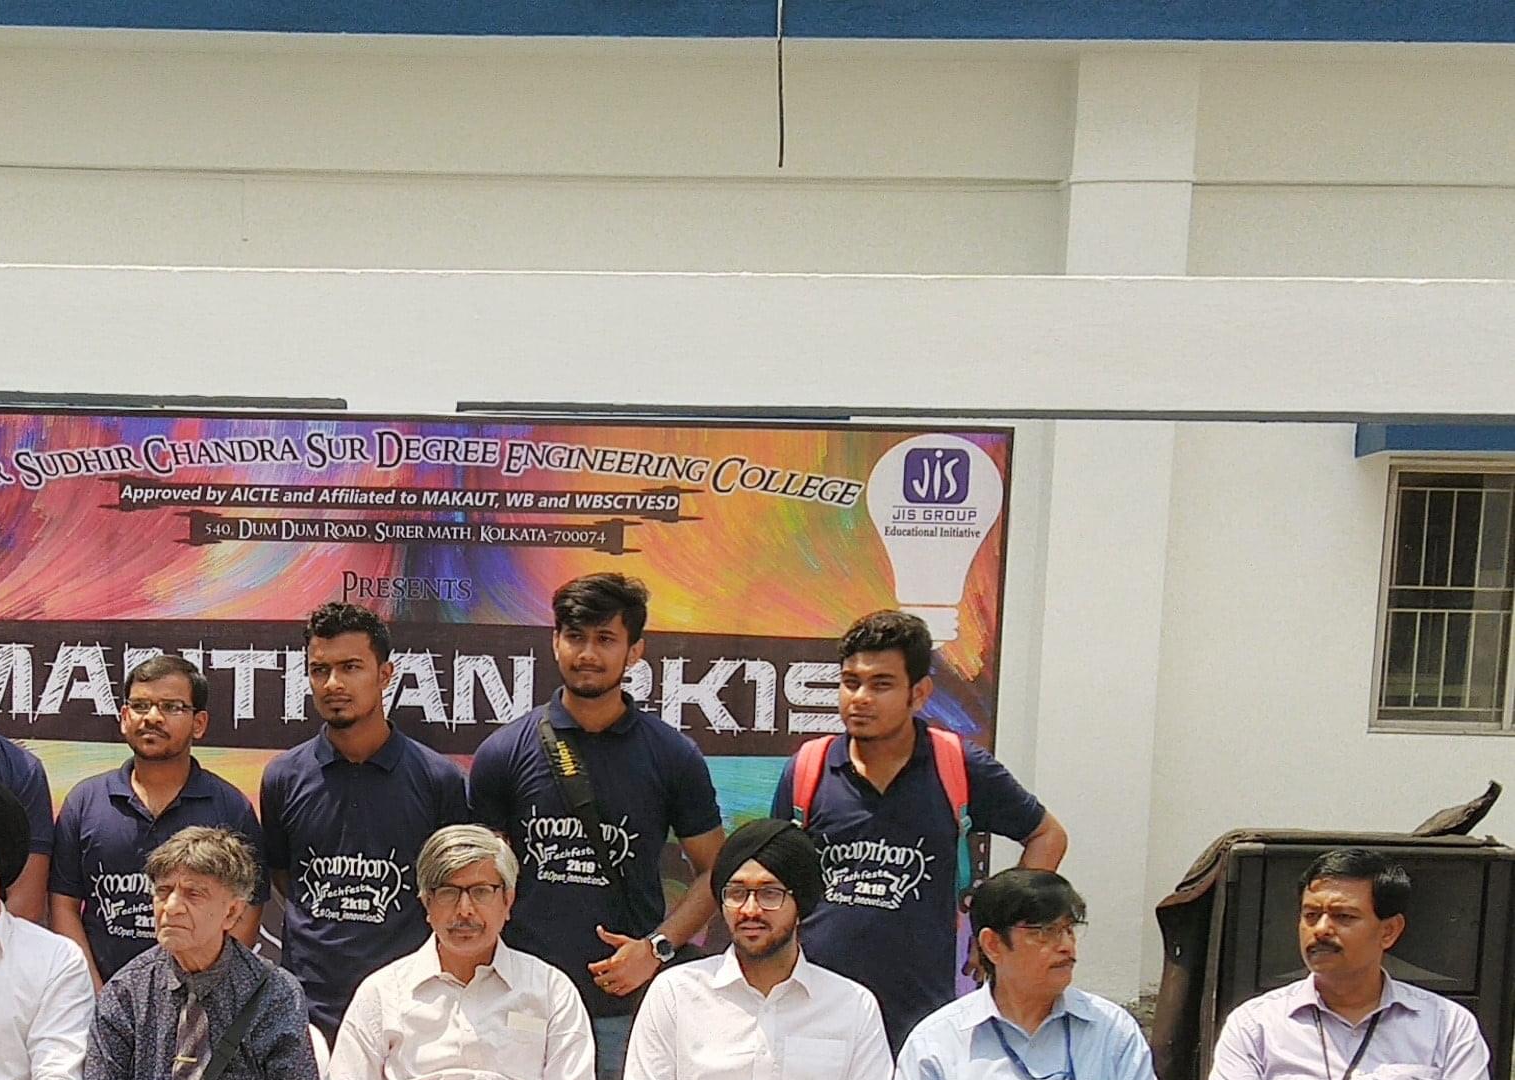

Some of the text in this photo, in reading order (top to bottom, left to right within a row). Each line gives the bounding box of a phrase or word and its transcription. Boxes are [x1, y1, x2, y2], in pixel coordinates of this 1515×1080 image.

[15, 446, 142, 488] SUDHIR
[143, 436, 298, 475] CHANDRA
[306, 432, 369, 469] SUR
[374, 430, 499, 469] DEGREE
[504, 441, 710, 482] ENGINEERING
[711, 456, 863, 505] COLLEGE
[120, 484, 679, 510] Approved by AICTE and Affiliated to MAKAUT, WB and WBSCTVESD
[892, 509, 978, 521] JIS GROUP
[238, 519, 277, 539] DUM
[281, 519, 320, 540] DUM
[374, 522, 424, 542] SURER
[479, 525, 607, 544] KOLKATA-700074
[884, 526, 982, 538] Educational Initiative
[342, 571, 473, 602] PRESENTS
[556, 740, 579, 777] Nikon
[115, 902, 154, 917] Techfes
